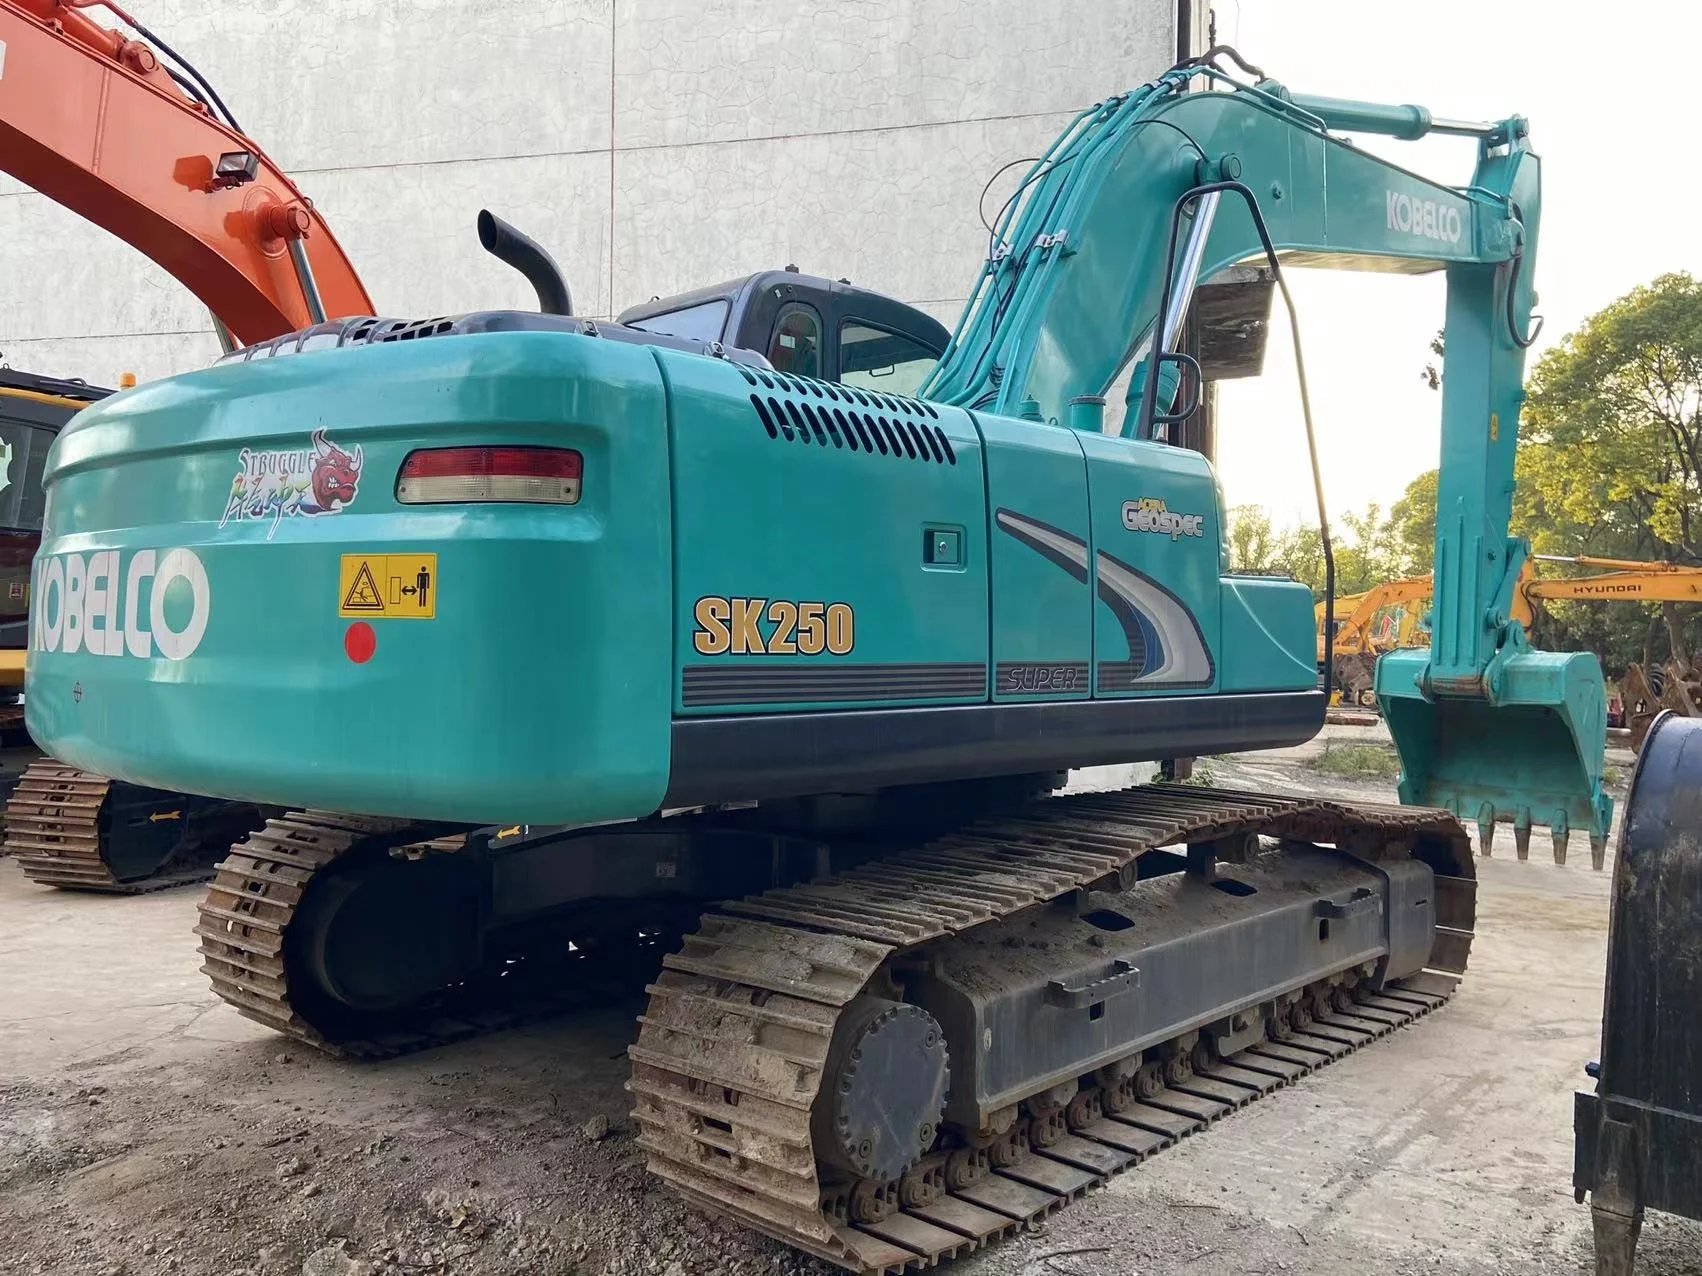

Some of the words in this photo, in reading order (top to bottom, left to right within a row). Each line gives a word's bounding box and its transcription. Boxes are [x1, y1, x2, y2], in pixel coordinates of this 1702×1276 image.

[1387, 190, 1461, 243] KOBELCO
[35, 548, 210, 660] KOBELCO
[1573, 584, 1642, 594] HYUNDAI
[694, 596, 854, 656] SK250
[1006, 667, 1078, 691] SUPER
